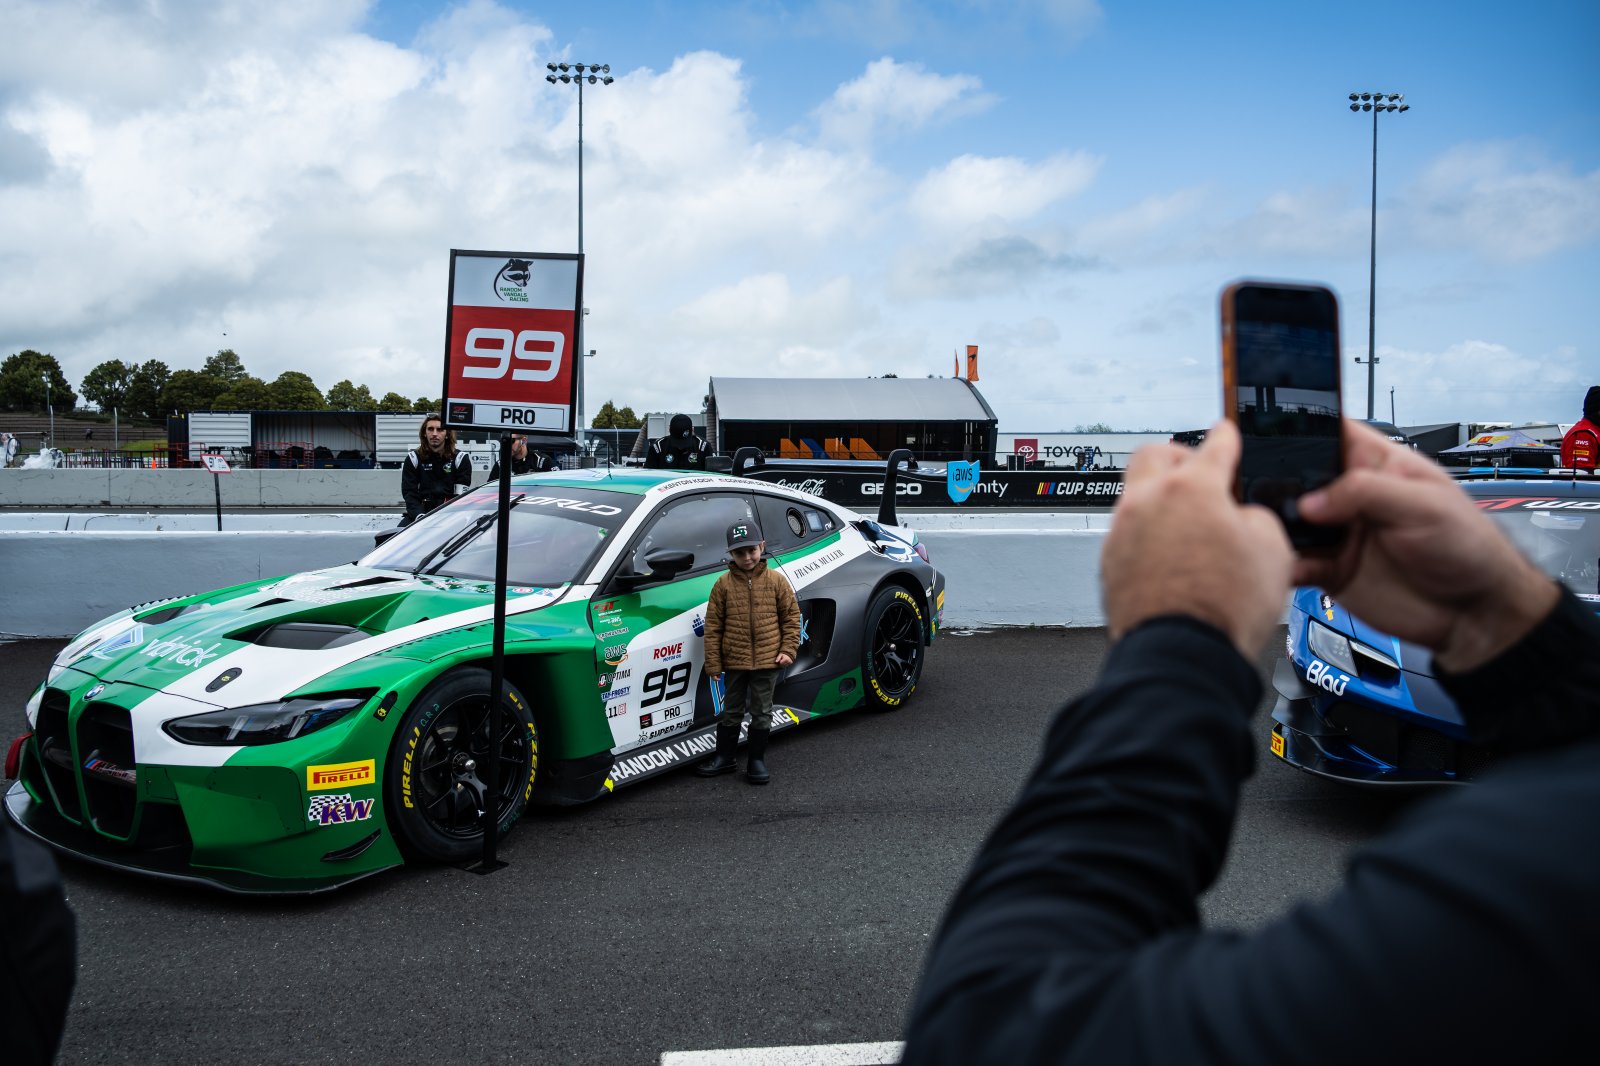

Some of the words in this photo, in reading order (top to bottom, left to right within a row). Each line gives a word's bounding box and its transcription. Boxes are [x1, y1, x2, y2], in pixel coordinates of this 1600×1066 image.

[462, 328, 565, 383] 99
[500, 407, 536, 426] PRO
[954, 468, 972, 482] aws
[860, 482, 922, 496] GECO
[1056, 482, 1085, 496] CUP
[794, 561, 821, 580] FRANCK
[818, 548, 845, 566] MULLER
[893, 591, 921, 621] PIRELLI
[604, 644, 627, 659] aws
[653, 643, 684, 660] ROWE
[606, 668, 632, 683] OPTIMA
[640, 661, 692, 709] 99
[664, 705, 681, 721] PRO
[649, 724, 676, 740] SUPER
[401, 727, 421, 809] PIRELLI
[609, 747, 680, 783] RANDOM
[313, 766, 370, 785] PIRELLI
[319, 798, 375, 826] KW
